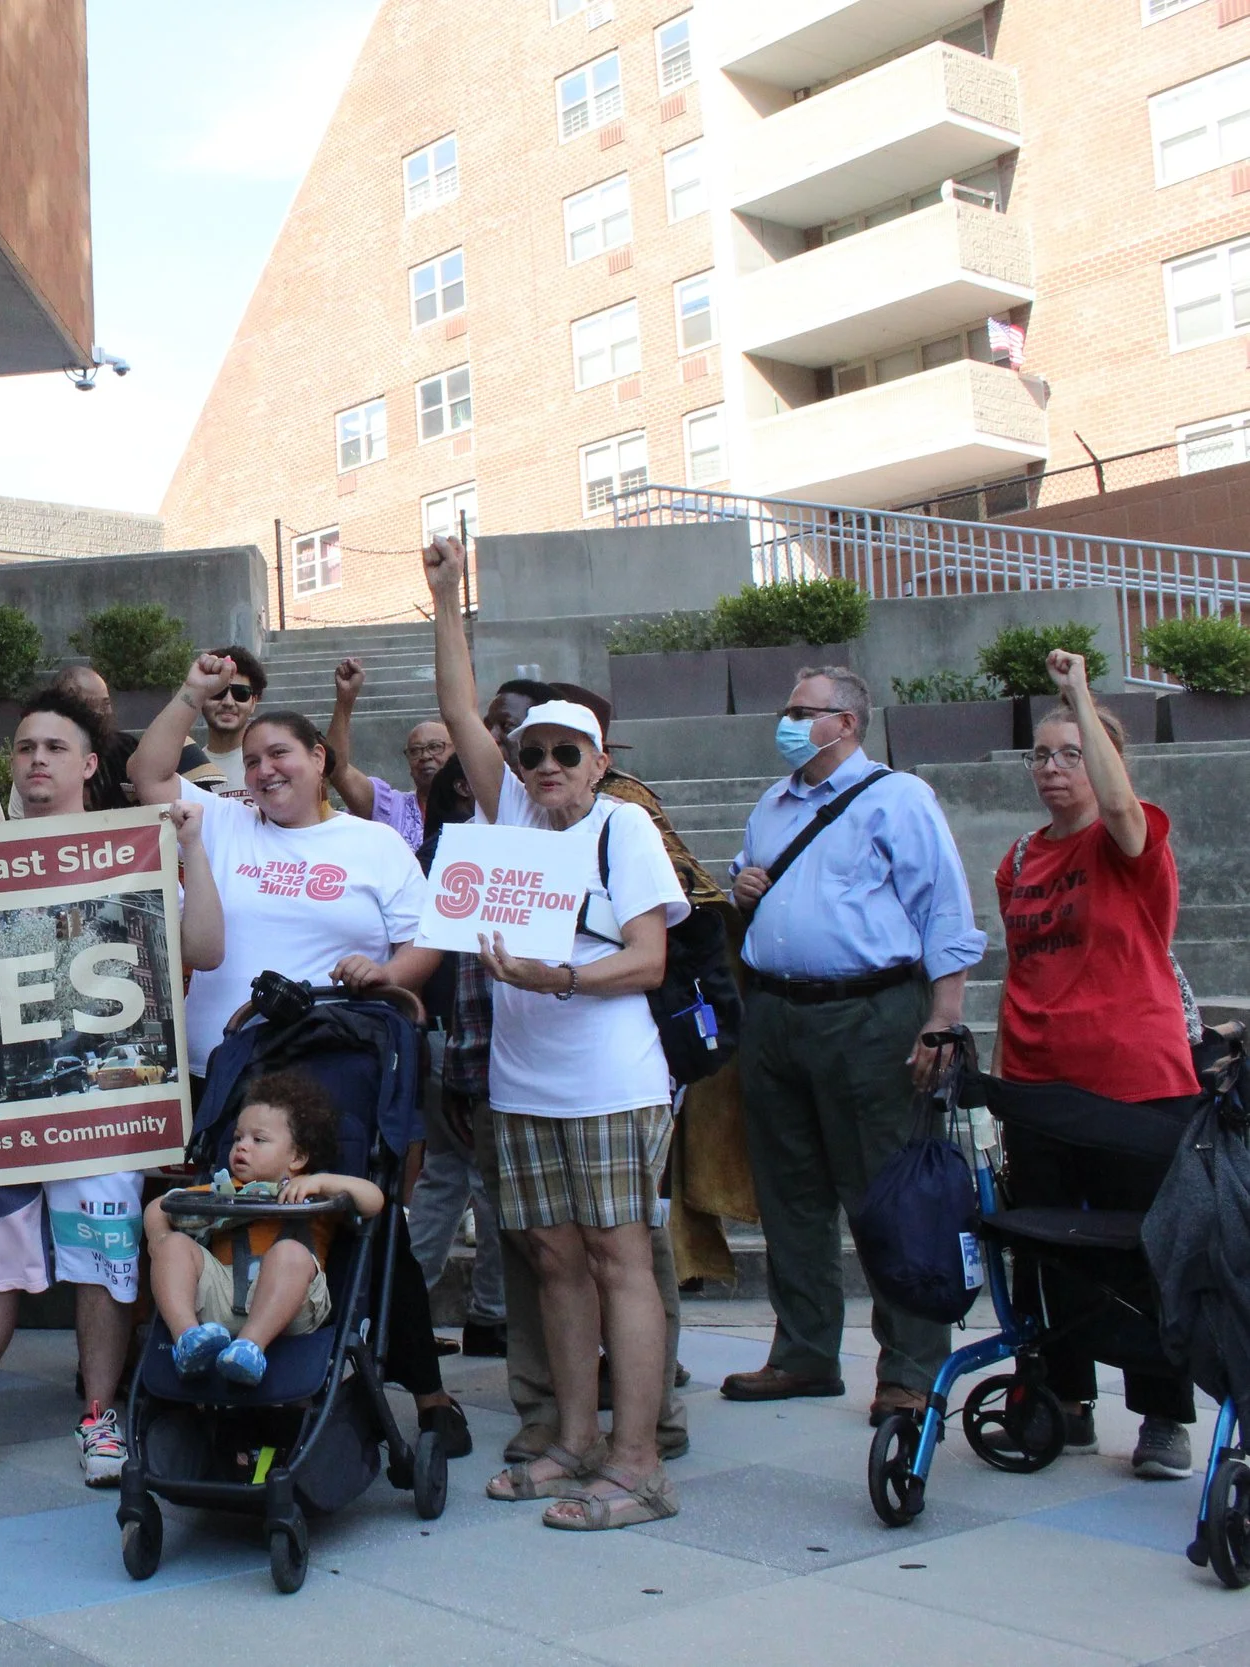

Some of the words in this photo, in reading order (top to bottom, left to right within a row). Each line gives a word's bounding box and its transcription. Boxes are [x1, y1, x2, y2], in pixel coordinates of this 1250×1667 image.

[57, 841, 135, 873] Side
[490, 867, 544, 888] SAVE
[485, 886, 576, 911] SECTION
[480, 905, 531, 925] NINE
[20, 1130, 38, 1148] &
[44, 1115, 167, 1145] Community
